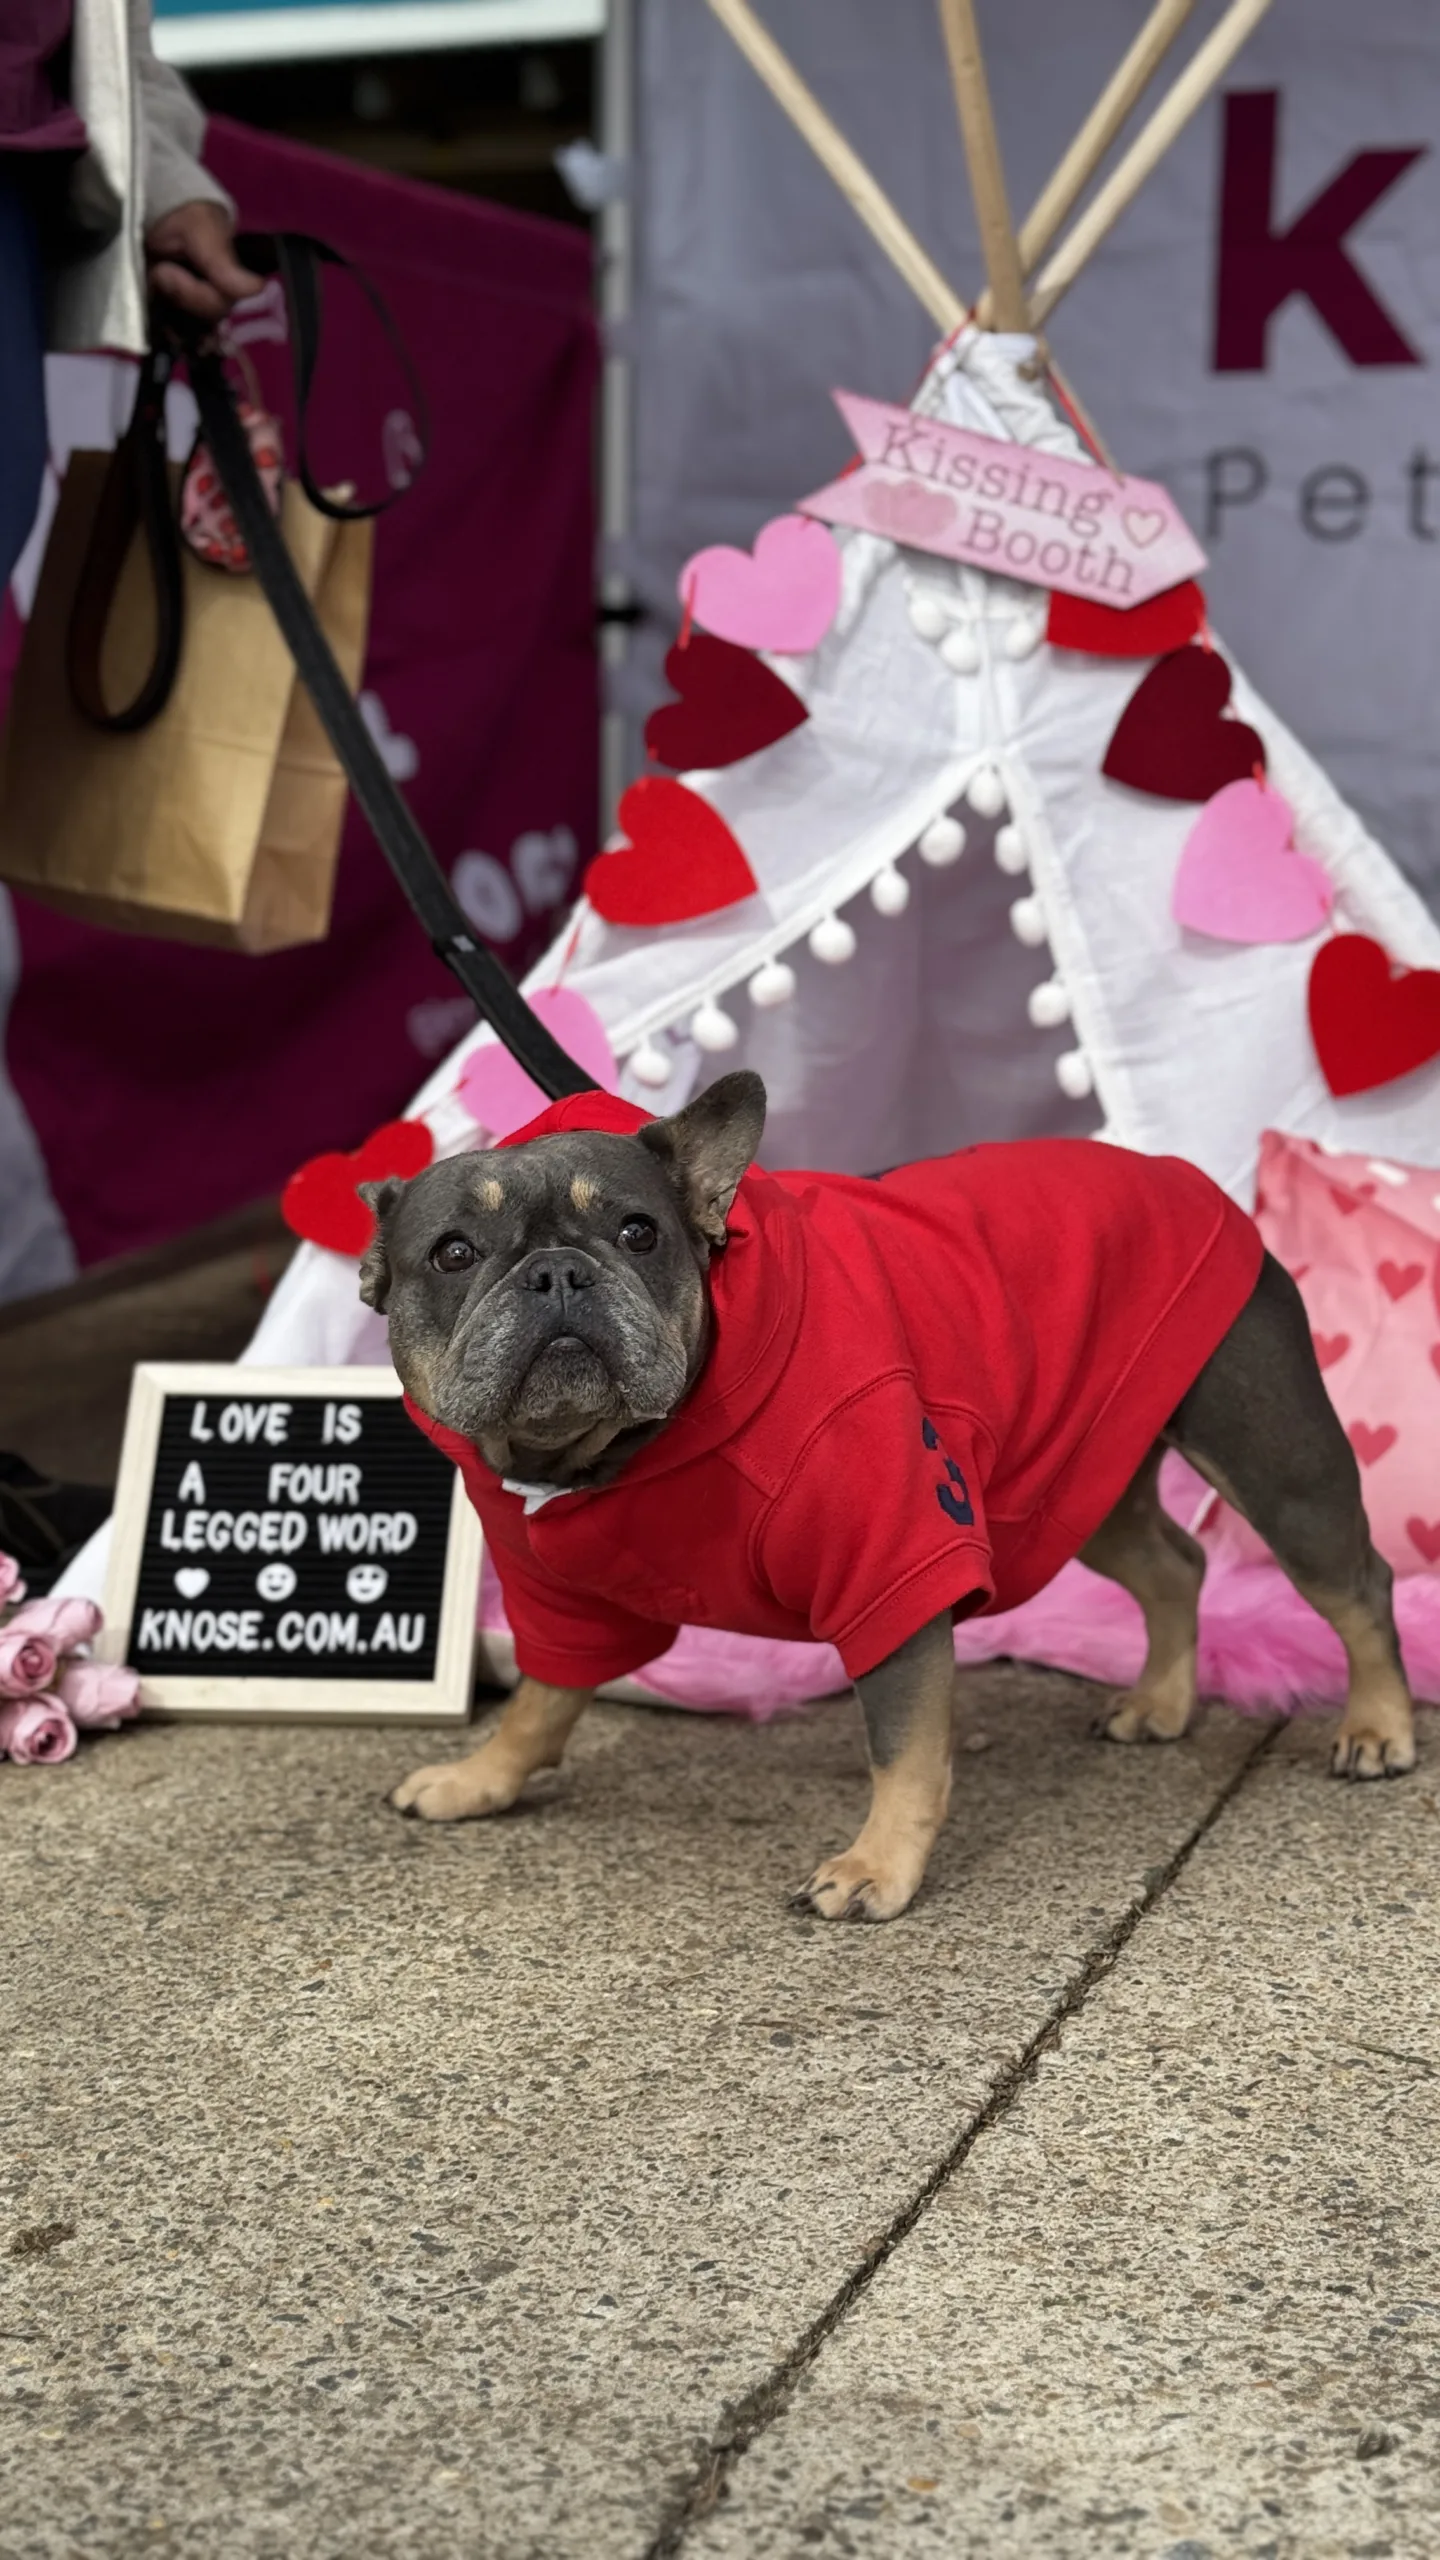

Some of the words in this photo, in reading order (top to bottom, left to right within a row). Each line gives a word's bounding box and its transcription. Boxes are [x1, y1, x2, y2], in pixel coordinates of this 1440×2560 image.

[880, 420, 1114, 538] Kissing
[1203, 440, 1440, 543] Pet
[960, 507, 1136, 594] Booth
[190, 1401, 293, 1445] LOVE
[322, 1402, 362, 1444] IS
[178, 1461, 206, 1505] A
[268, 1463, 361, 1505] FOUR
[160, 1509, 308, 1554] LEGGED
[317, 1511, 418, 1554] WORD
[138, 1608, 426, 1654] KNOSE.COM.AU
